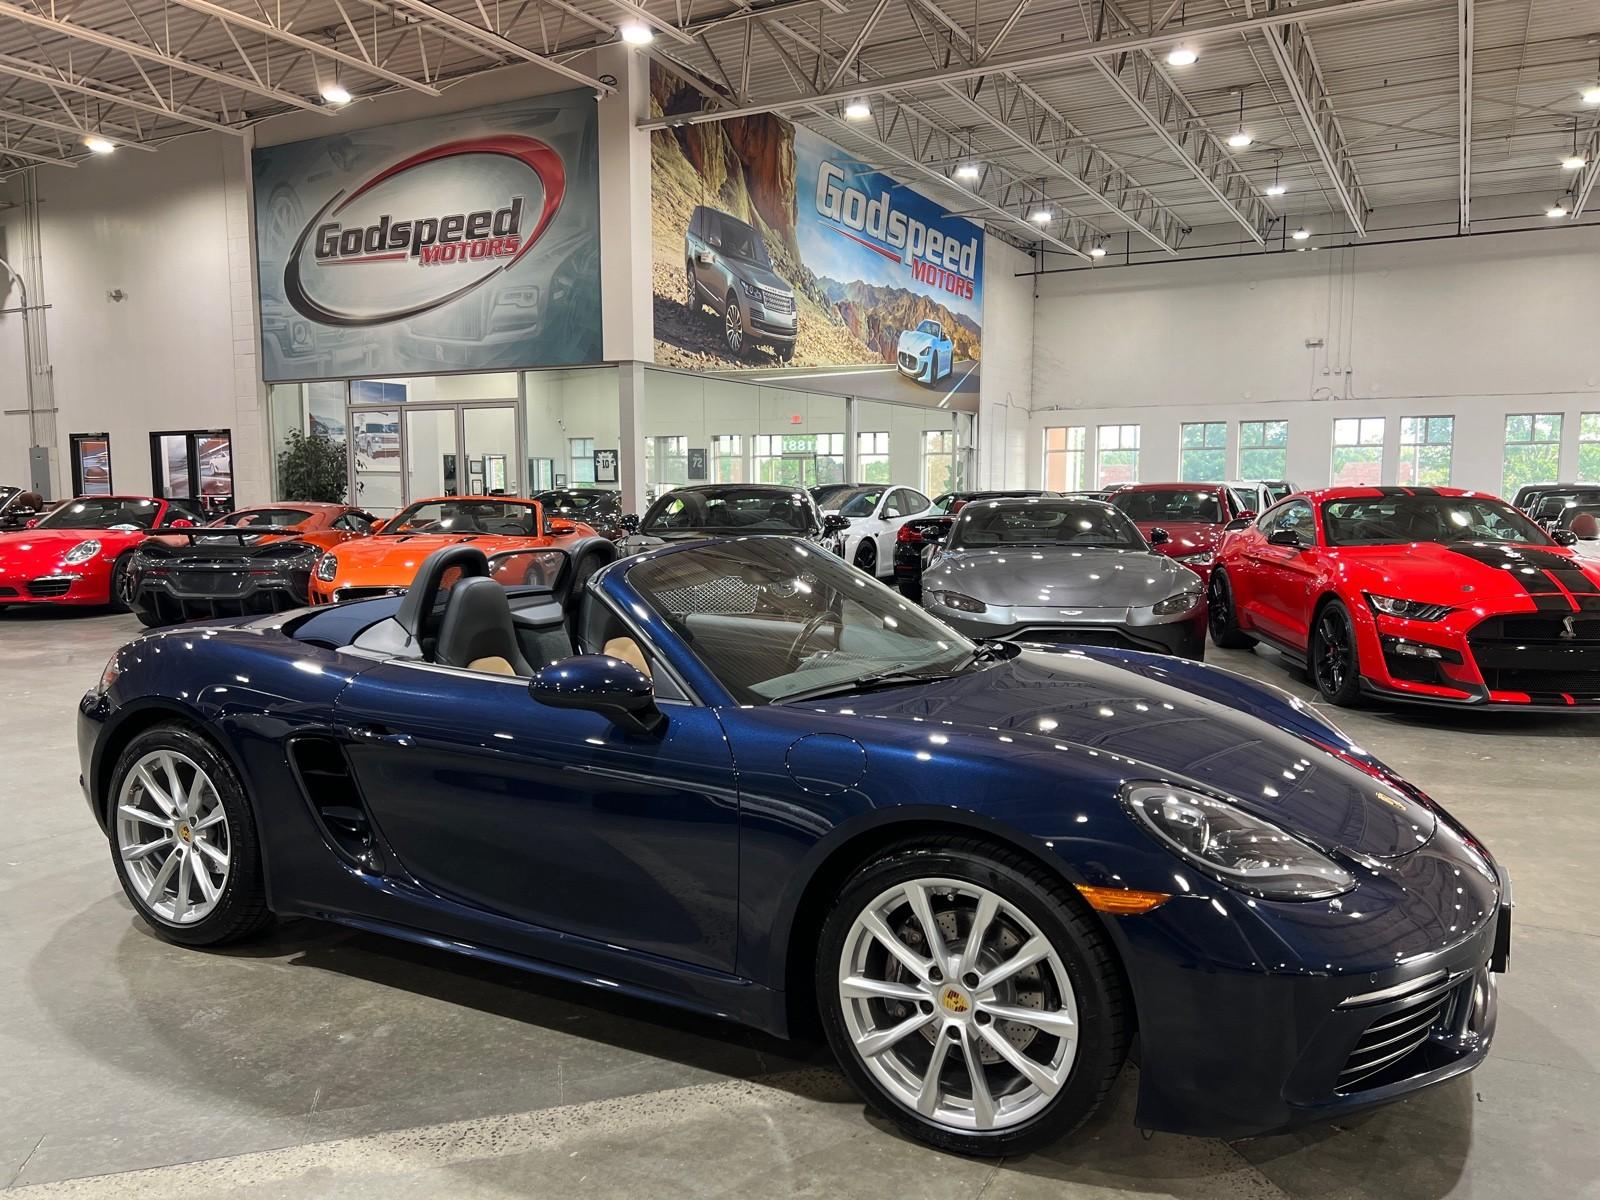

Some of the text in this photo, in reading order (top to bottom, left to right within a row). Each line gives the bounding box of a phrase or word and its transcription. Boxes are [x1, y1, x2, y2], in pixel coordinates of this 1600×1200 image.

[315, 196, 524, 259] Godspeed
[816, 160, 978, 279] Godspeed
[419, 235, 522, 267] MOTORS
[911, 258, 975, 301] MOTORS
[602, 459, 610, 469] 10
[693, 456, 703, 468] 72
